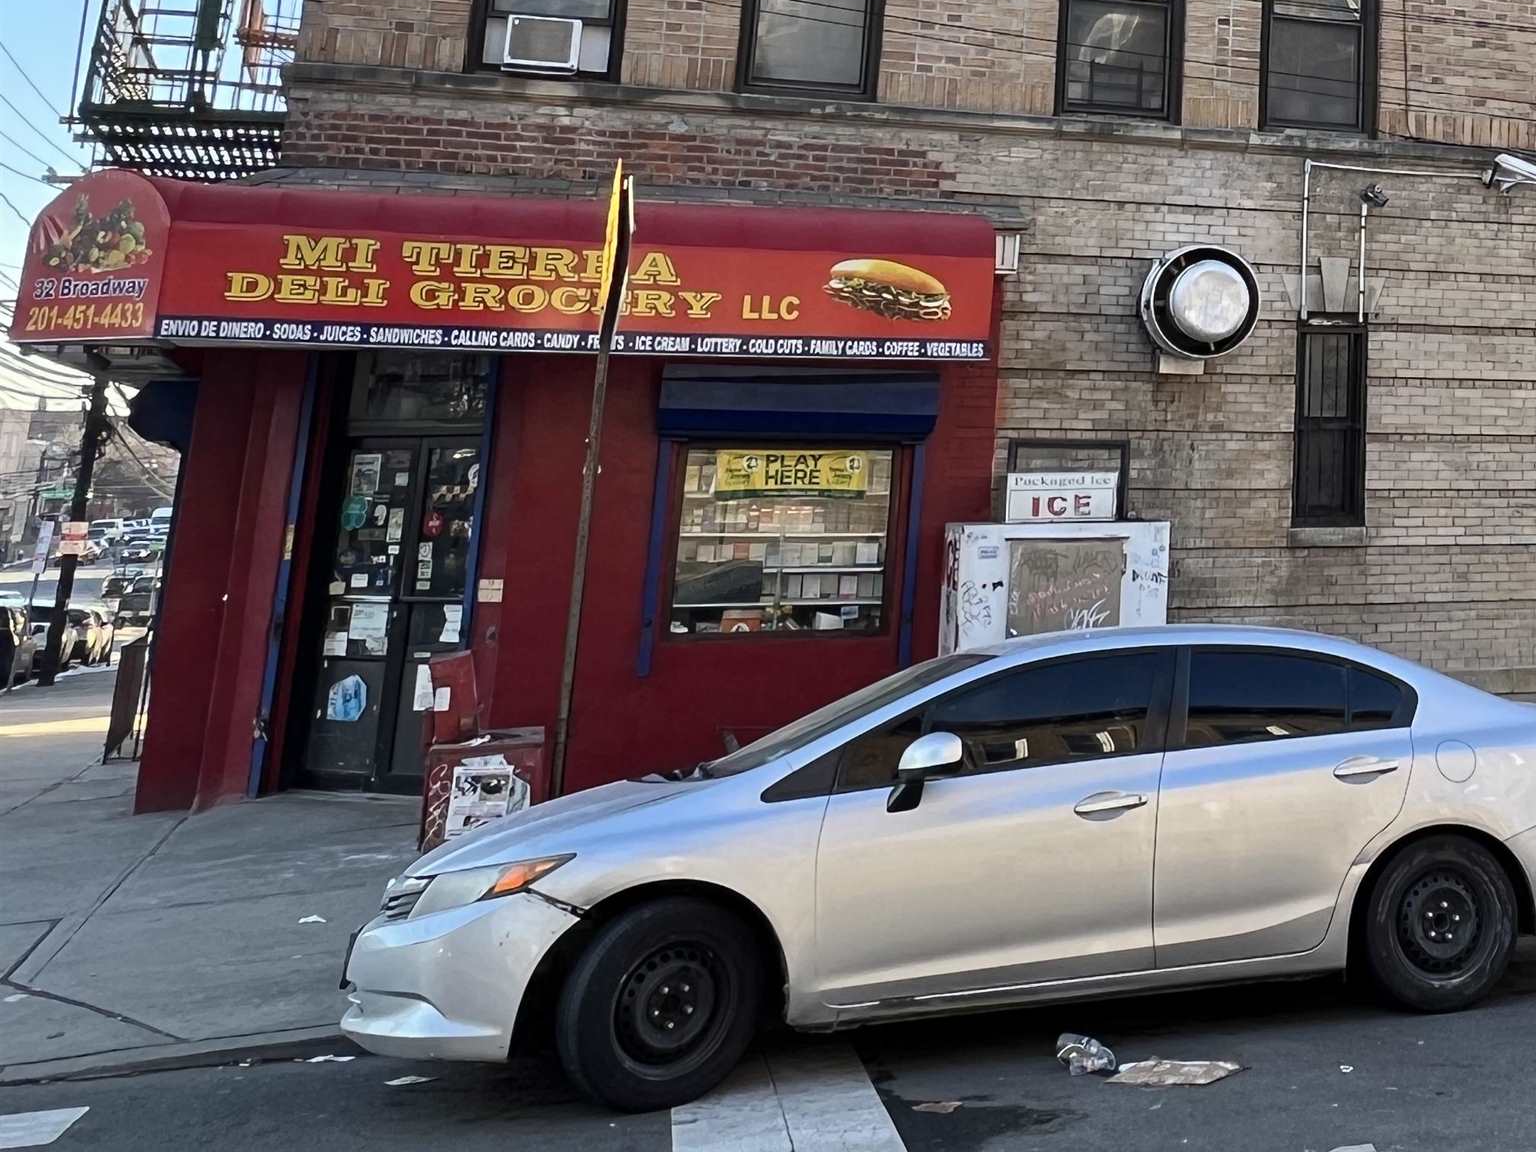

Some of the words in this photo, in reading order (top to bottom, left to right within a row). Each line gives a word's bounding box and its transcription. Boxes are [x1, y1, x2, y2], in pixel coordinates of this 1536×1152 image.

[280, 235, 380, 272] MI
[33, 278, 57, 299] 32
[59, 276, 148, 301] Broadway
[224, 272, 391, 307] DELI
[742, 295, 801, 321] LLC
[25, 302, 144, 331] 201-451-4433
[160, 319, 198, 336] ENVIO
[201, 321, 217, 337] DE
[219, 322, 264, 338] DINERO
[273, 324, 311, 340] SODAS
[319, 326, 361, 342] JUICES
[369, 327, 442, 345] SANDWICHES
[451, 329, 497, 346] CALLING
[499, 331, 535, 347] CARDS
[544, 333, 579, 349] CANDY
[587, 334, 624, 350] FRTS
[635, 336, 652, 350] ICE
[654, 337, 690, 352] CREAM
[697, 338, 742, 353] LOTTERY
[749, 339, 775, 354] COLD
[777, 339, 803, 354] CUTS
[809, 340, 844, 355] FAMILY
[845, 341, 877, 356] CARDS
[884, 342, 919, 356] COFFEE
[926, 343, 984, 357] VEGETABLES
[765, 454, 824, 468] PLAY
[764, 469, 821, 485] HERE
[1091, 476, 1111, 485] Ice
[1031, 494, 1092, 517] ICE
